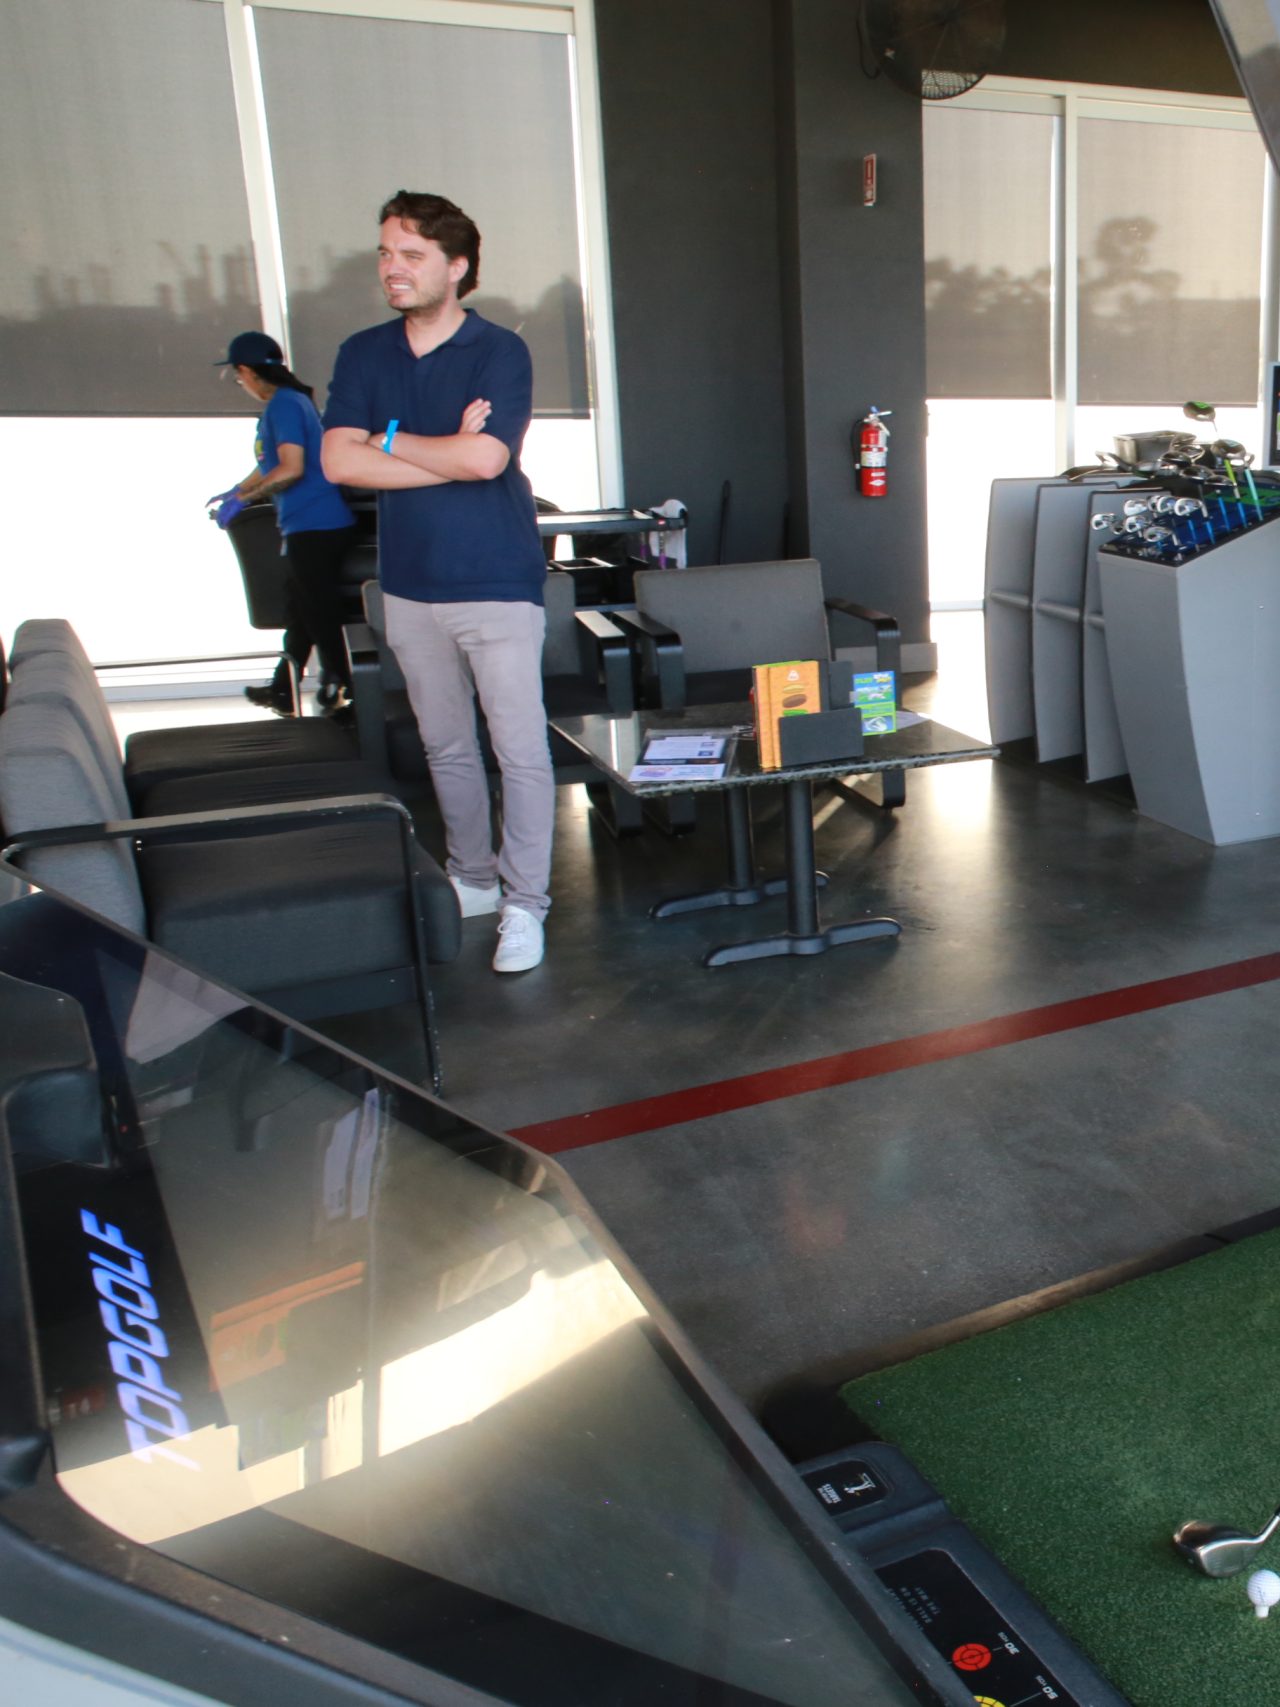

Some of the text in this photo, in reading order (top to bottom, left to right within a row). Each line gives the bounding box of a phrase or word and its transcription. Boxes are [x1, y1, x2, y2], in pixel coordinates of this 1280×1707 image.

[79, 1207, 203, 1472] TOPGOLF
[1004, 1642, 1020, 1655] 30
[1042, 1686, 1059, 1700] 50
